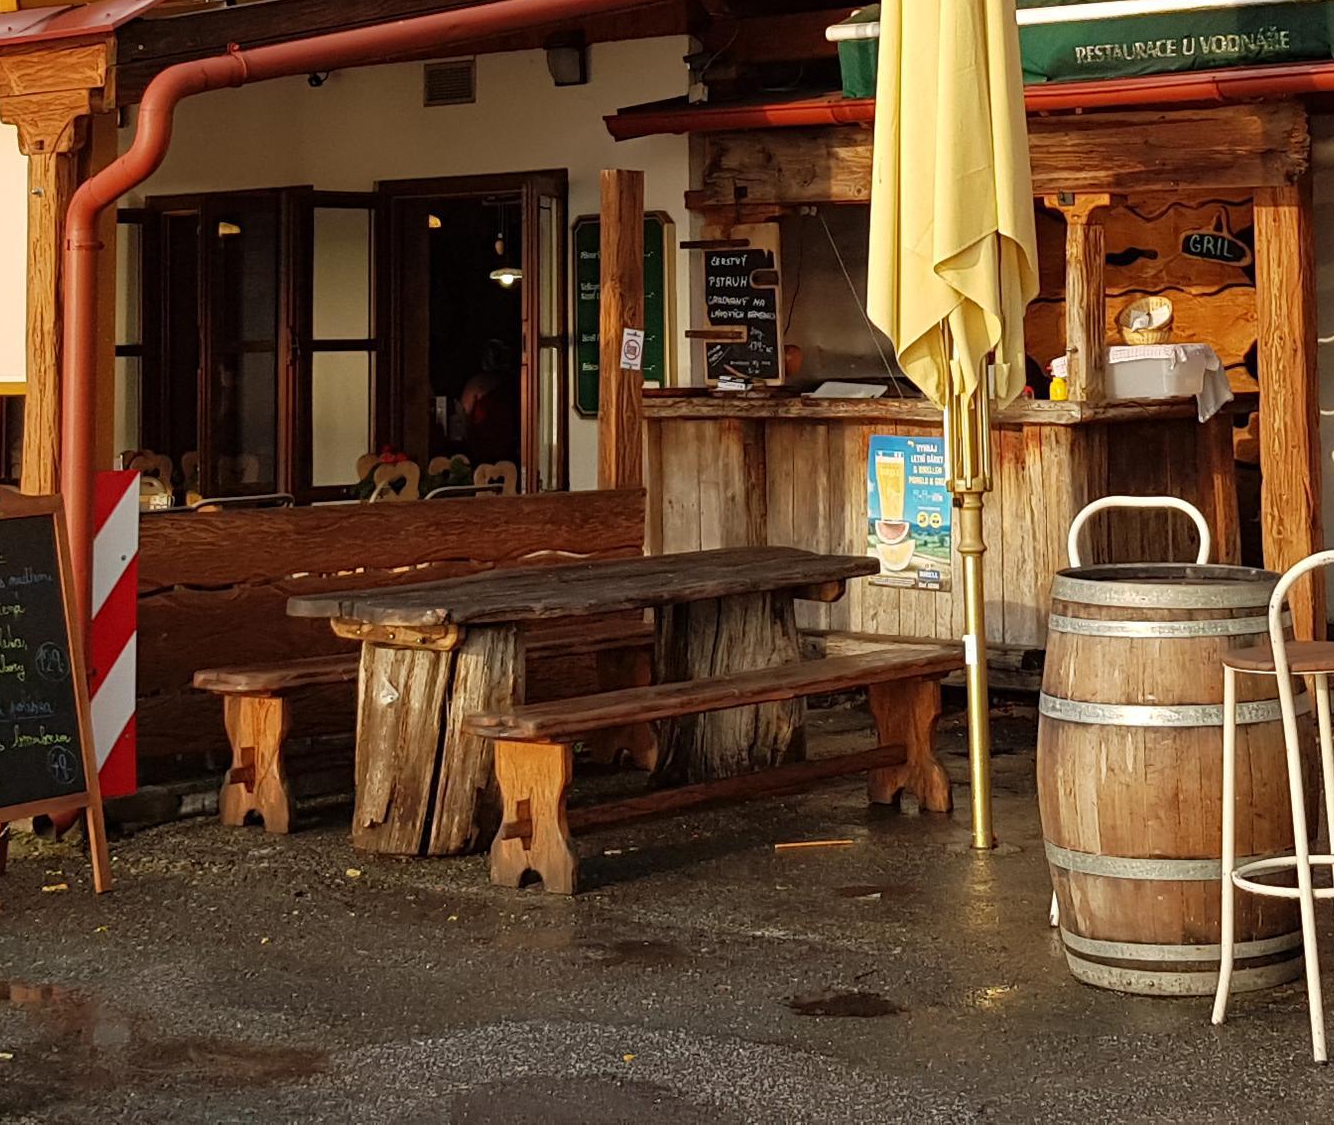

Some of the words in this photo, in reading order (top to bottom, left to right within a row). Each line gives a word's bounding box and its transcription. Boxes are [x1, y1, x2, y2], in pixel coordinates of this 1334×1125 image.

[1075, 38, 1177, 64] RESTAURACE
[1182, 35, 1195, 56] U
[1197, 25, 1290, 55] VODNÁŘE
[1188, 234, 1234, 258] GRIL
[708, 276, 748, 288] PSTRUH
